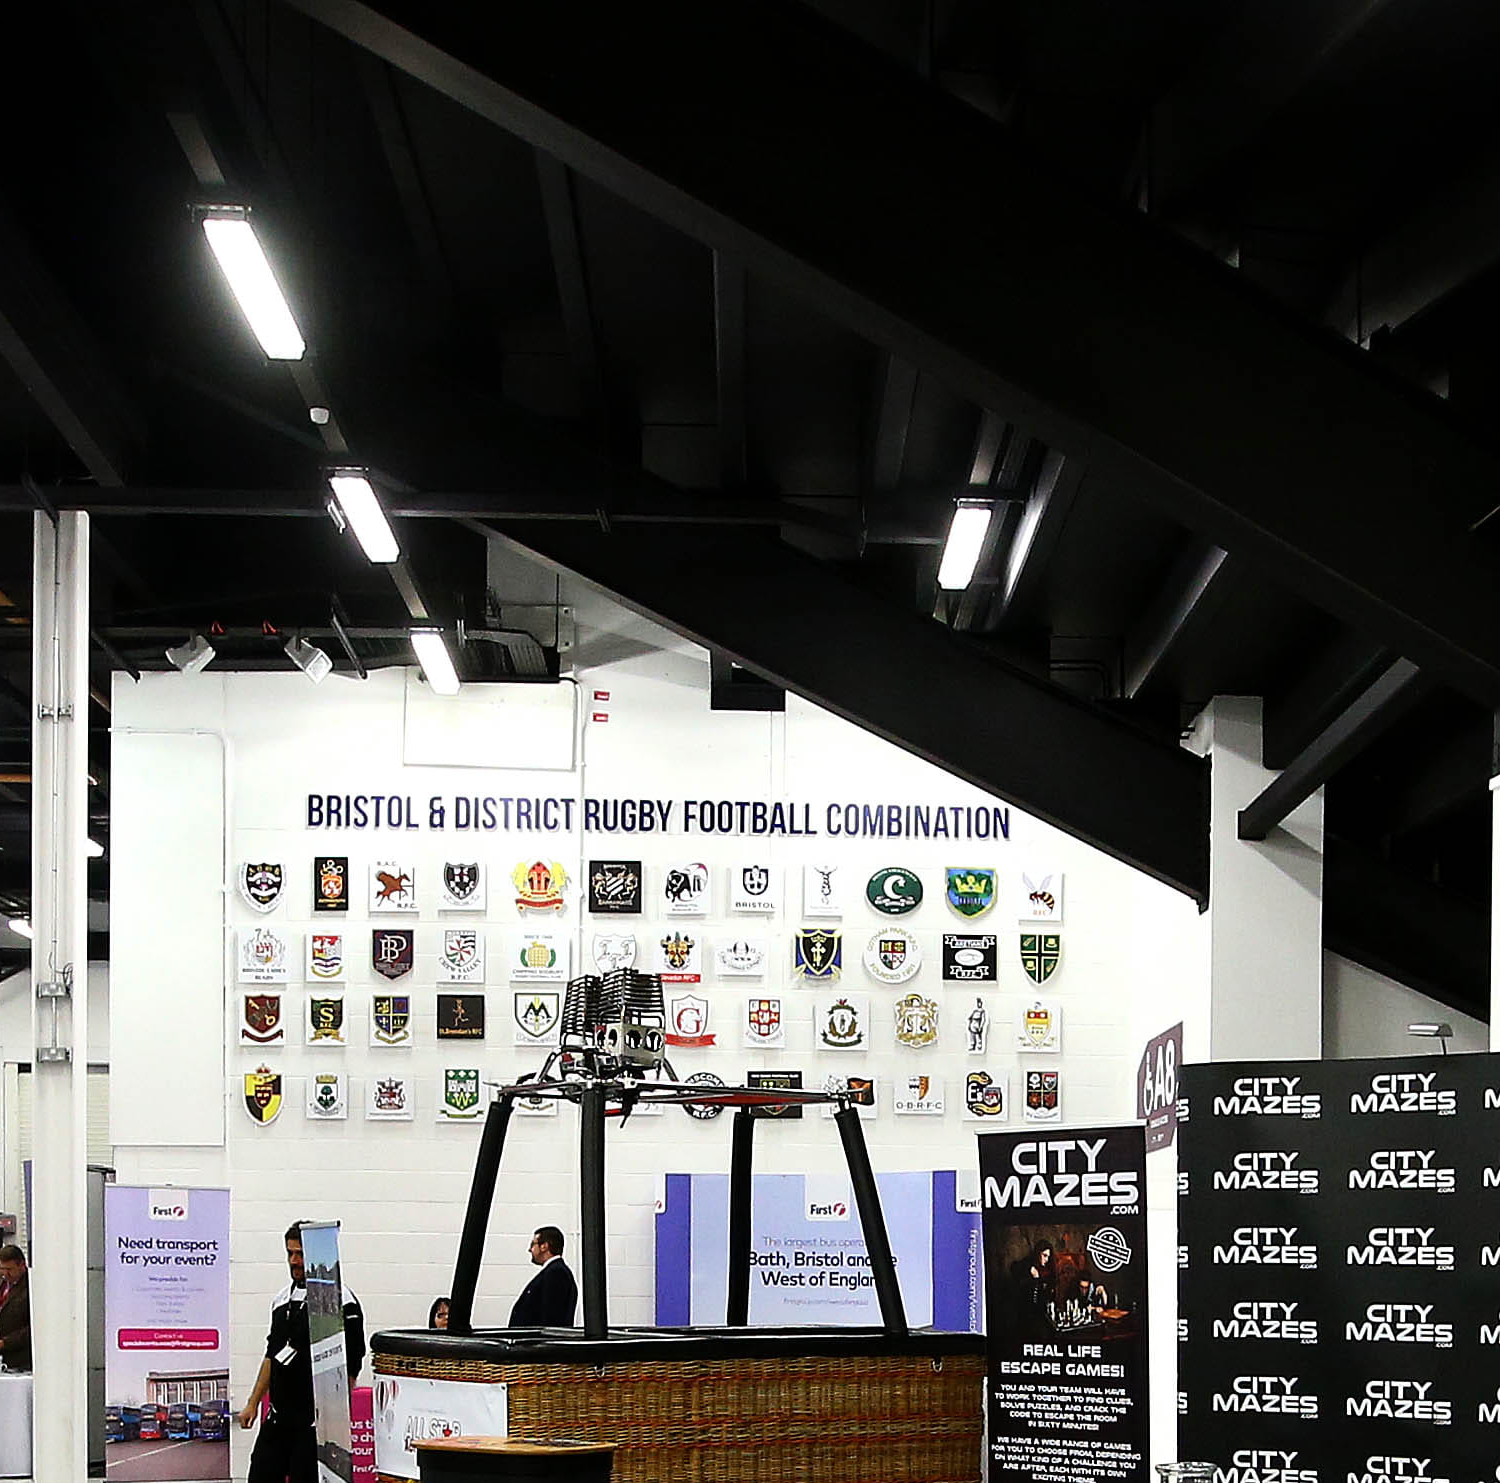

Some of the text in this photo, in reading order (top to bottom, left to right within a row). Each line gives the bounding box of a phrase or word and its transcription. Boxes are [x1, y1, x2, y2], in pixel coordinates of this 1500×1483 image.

[307, 794, 1010, 839] BRISTOL & DISTRICT RUGBY FOOTBALL COMBINATION
[735, 901, 775, 909] BRISTOL
[1234, 1078, 1300, 1095] CITY
[1372, 1073, 1436, 1093] CITY
[1214, 1095, 1320, 1114] MAZES
[1351, 1091, 1455, 1112] MAZES
[1011, 1138, 1107, 1175] CITY
[984, 1171, 1139, 1208] MAZES
[153, 1206, 172, 1216] First
[810, 1204, 833, 1215] First
[1110, 1205, 1139, 1215] .COM
[118, 1236, 219, 1252] Need transport
[763, 1236, 836, 1248] The largest bus
[121, 1252, 217, 1267] for your event?
[794, 1251, 844, 1267] Bristol
[761, 1271, 806, 1287] West
[809, 1271, 826, 1286] of
[1023, 1344, 1102, 1358] REAL LIFE
[1001, 1361, 1125, 1378] ESCAPE GAMES!
[404, 1415, 426, 1440] ALL
